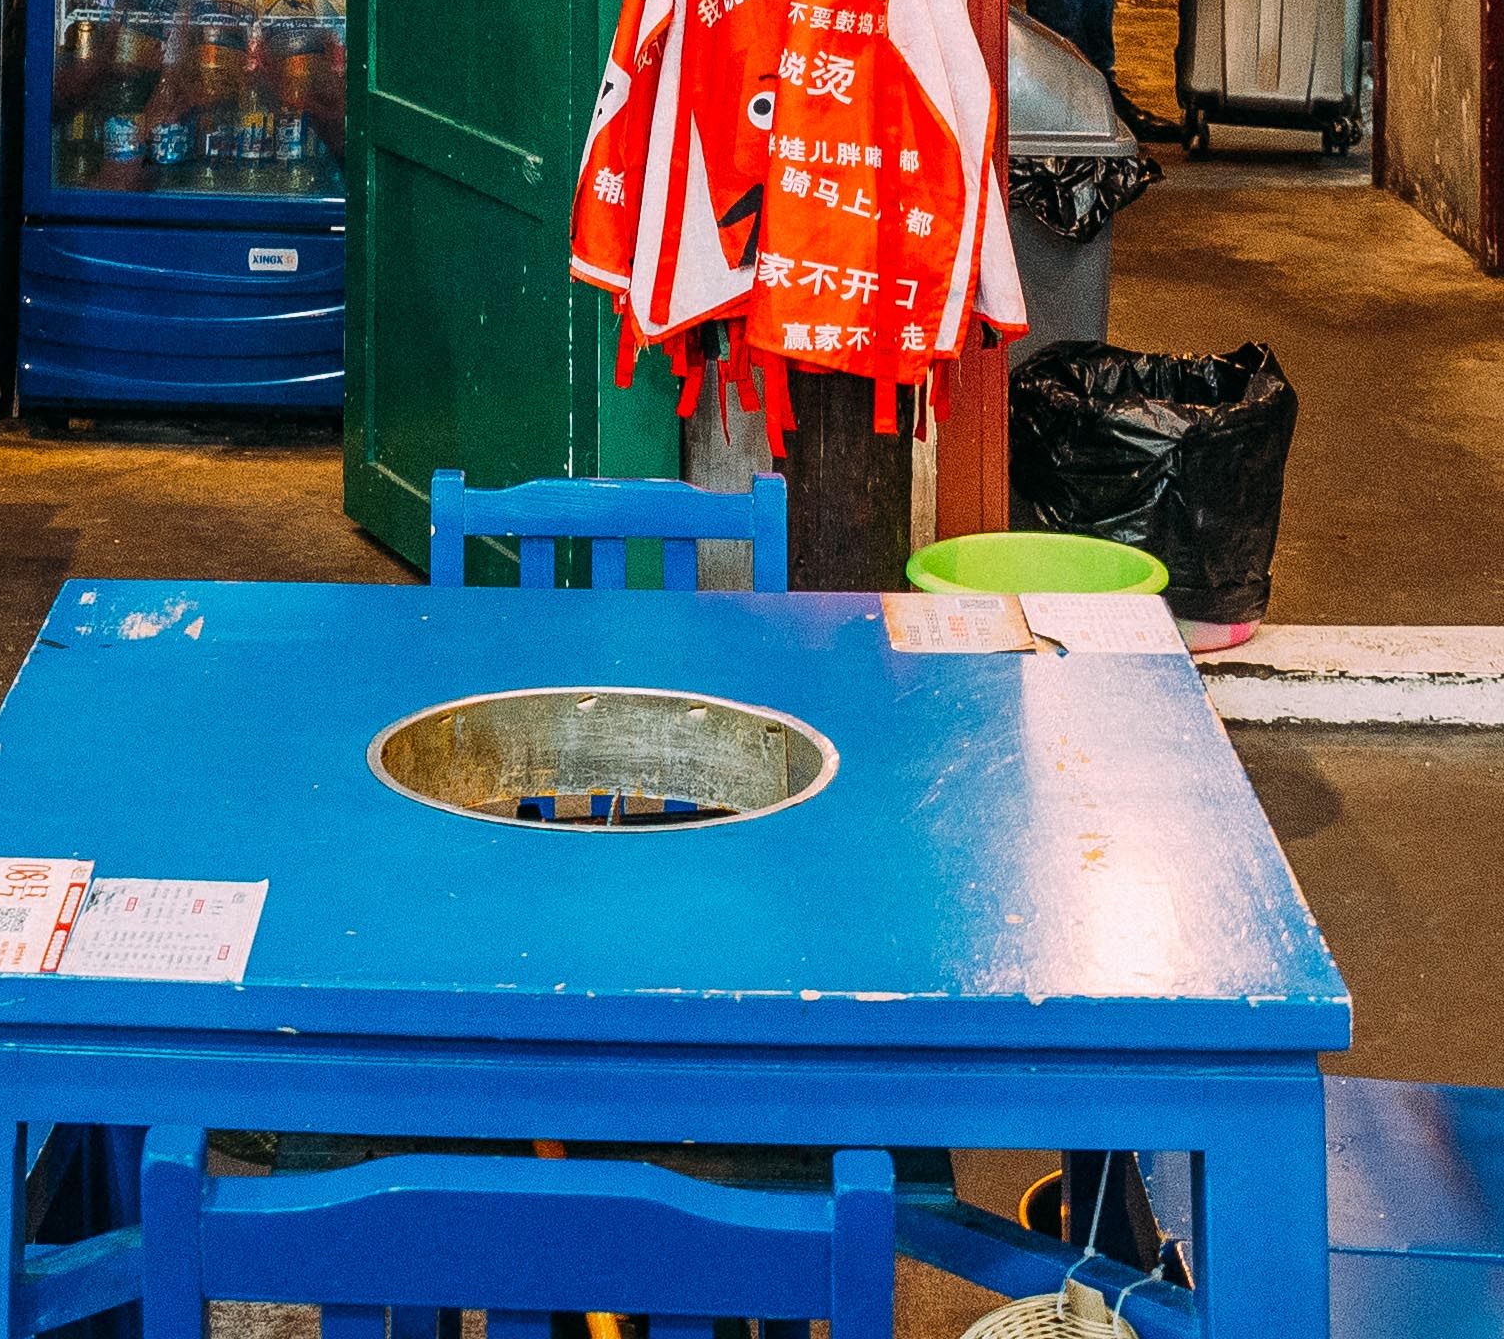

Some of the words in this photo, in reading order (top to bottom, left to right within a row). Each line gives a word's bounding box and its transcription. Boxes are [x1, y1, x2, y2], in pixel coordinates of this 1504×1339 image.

[780, 165, 935, 239] 骑马上都
[781, 321, 927, 352] 赢家不走
